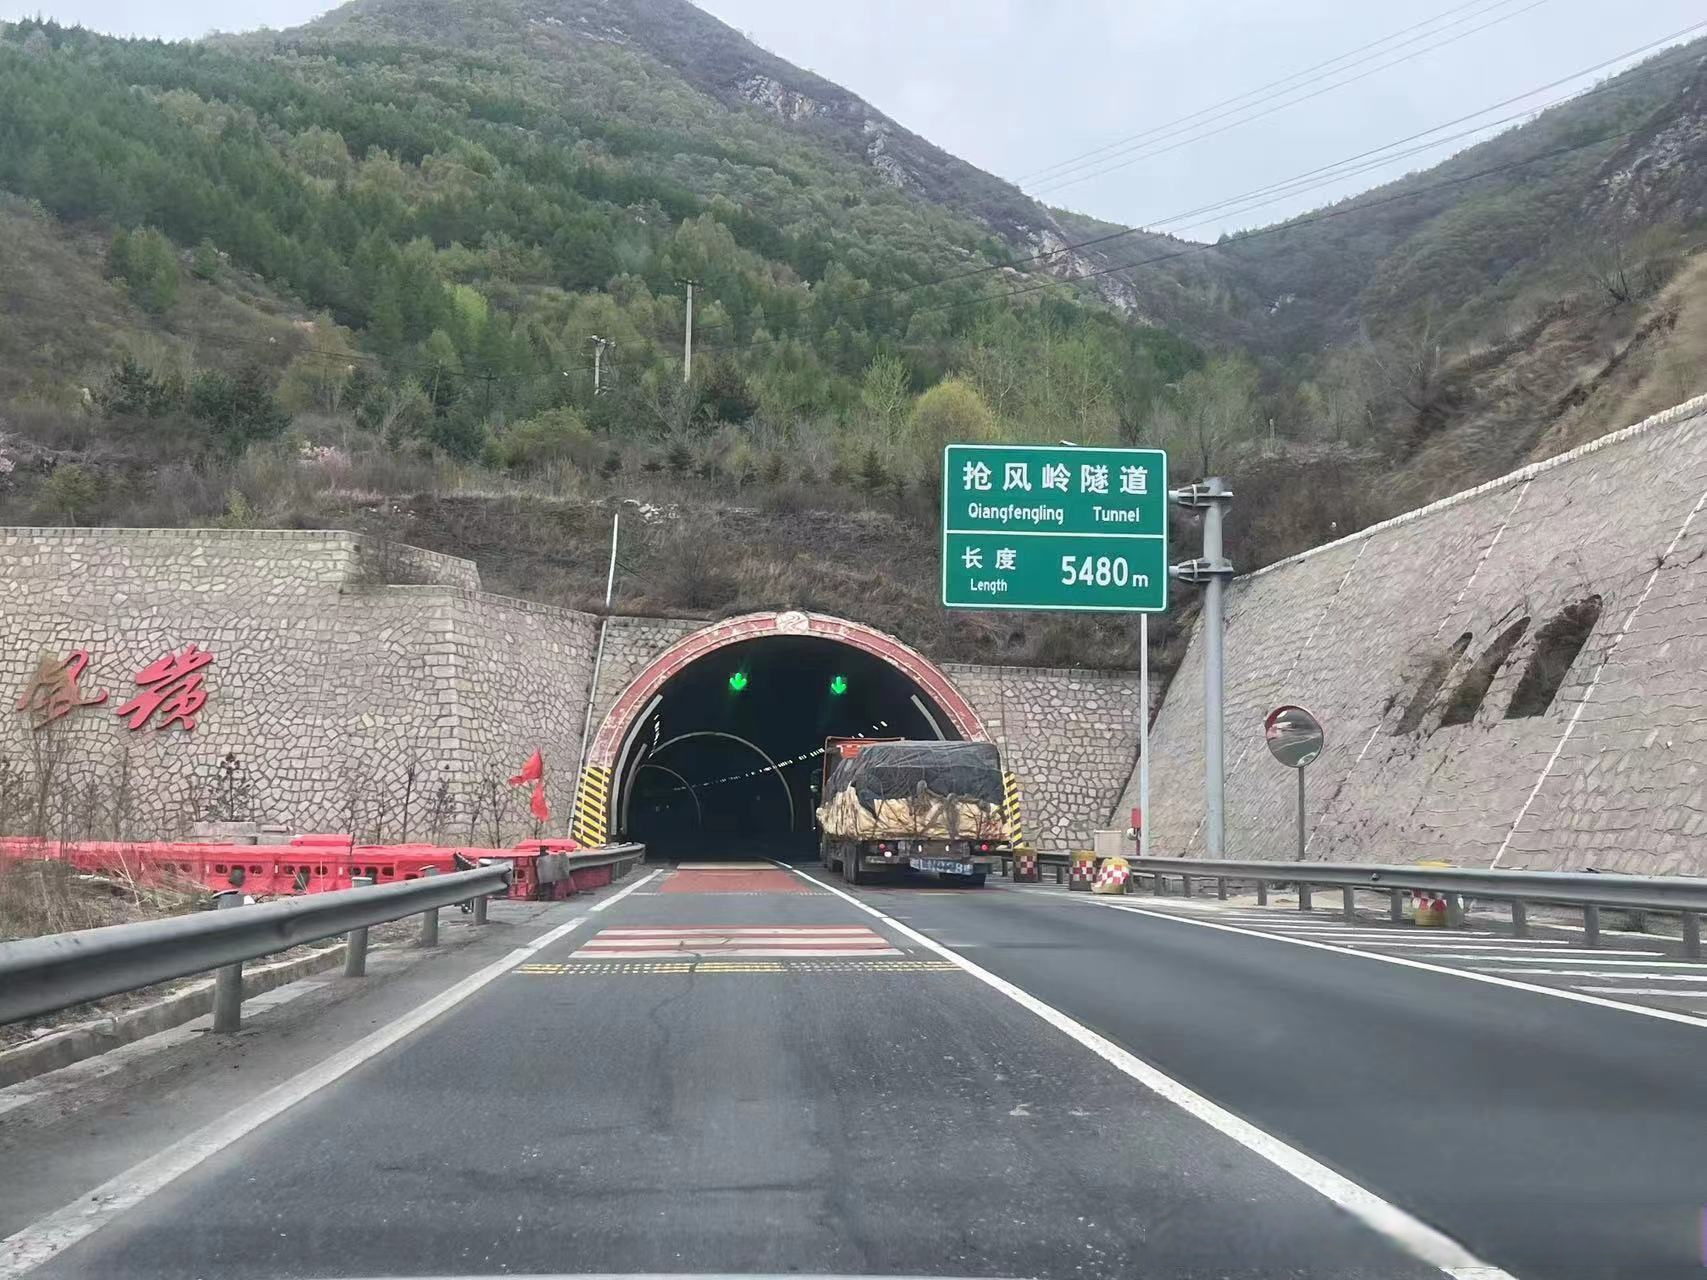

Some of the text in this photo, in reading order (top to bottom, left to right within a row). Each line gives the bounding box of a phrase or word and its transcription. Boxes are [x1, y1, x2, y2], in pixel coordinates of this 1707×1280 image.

[962, 461, 1148, 495] 抢风岭隧道
[968, 502, 1140, 525] Qiangfengling Tunnel
[961, 546, 1017, 570] 长度
[970, 578, 1008, 595] Length
